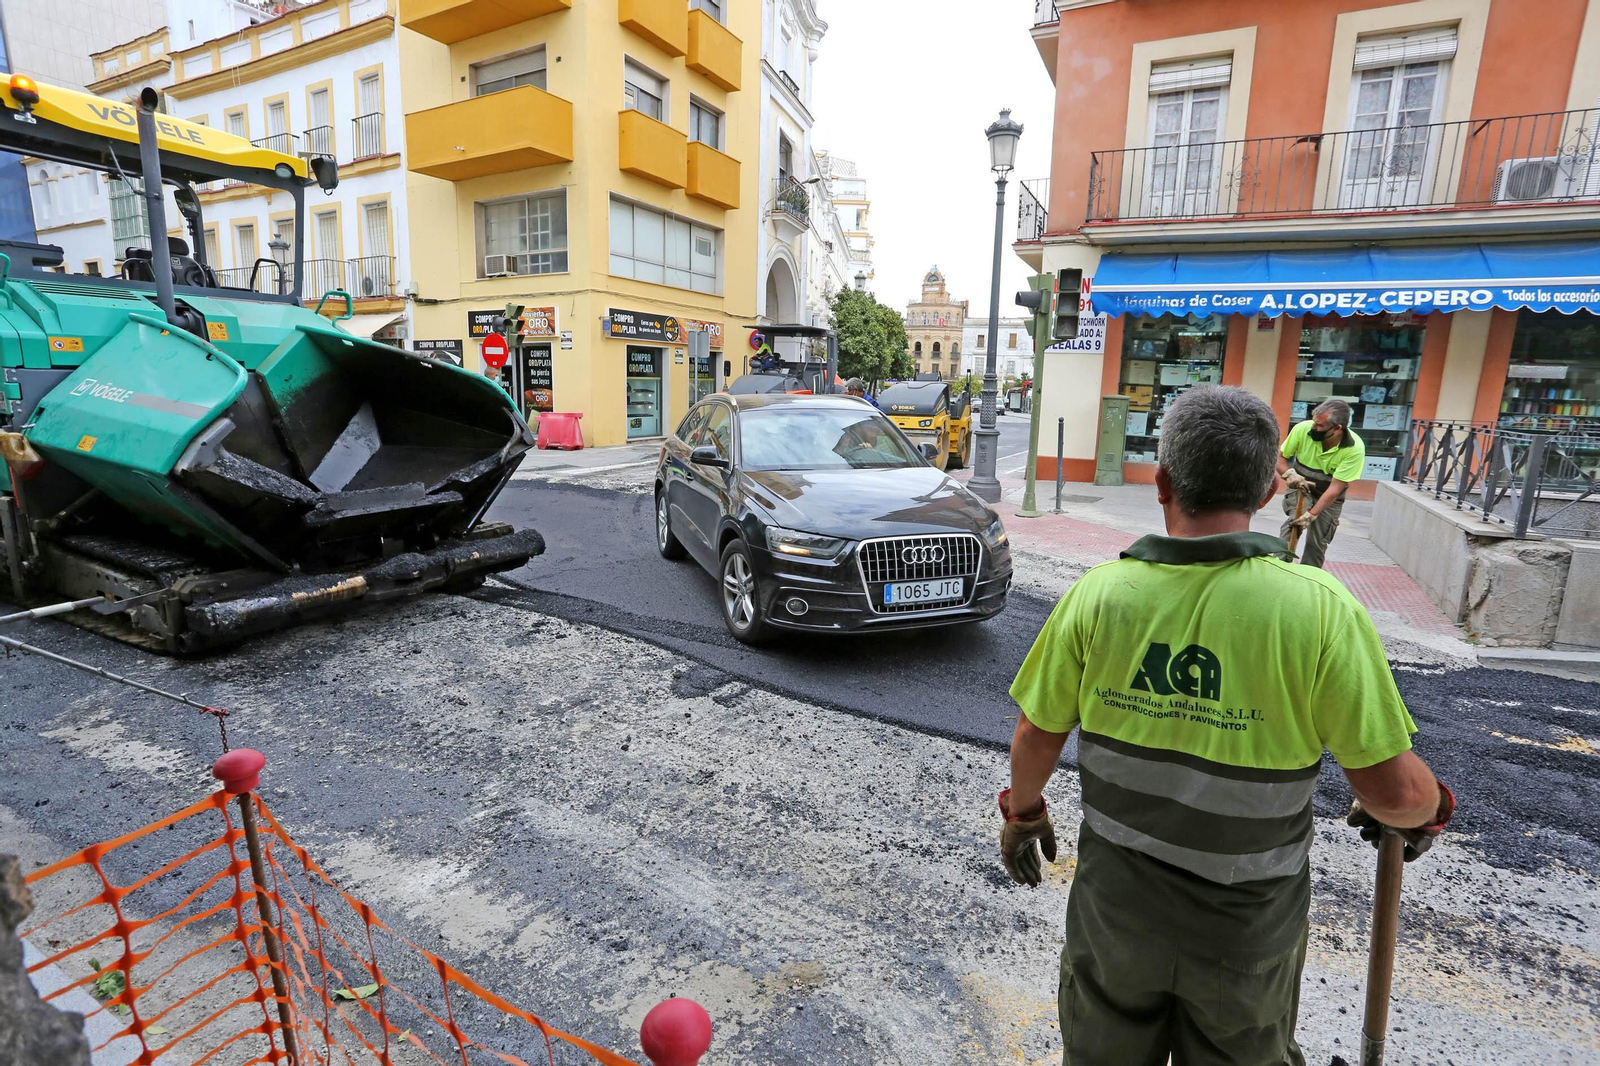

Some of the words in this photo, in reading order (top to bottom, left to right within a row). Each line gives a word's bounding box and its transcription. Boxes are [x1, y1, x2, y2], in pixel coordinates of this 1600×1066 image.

[87, 103, 206, 145] VÖELE
[1189, 294, 1208, 307] de
[1212, 294, 1254, 306] Coser
[1537, 289, 1552, 302] los
[528, 318, 549, 328] ORO
[614, 313, 634, 323] COMPRO
[611, 324, 637, 334] ORO/PLATA
[704, 323, 721, 336] ORO
[1095, 340, 1101, 350] 9
[631, 353, 651, 361] COMPRO
[629, 364, 653, 372] ORO/PLATA
[88, 382, 134, 403] VÖGELE
[897, 583, 930, 600] 1065
[936, 581, 960, 596] JTC
[1093, 686, 1163, 709] Aglomerados
[1104, 699, 1180, 719] CONSTRUCCIONES
[1182, 712, 1188, 720] Y
[1190, 714, 1248, 731] PAVIMENTOS
